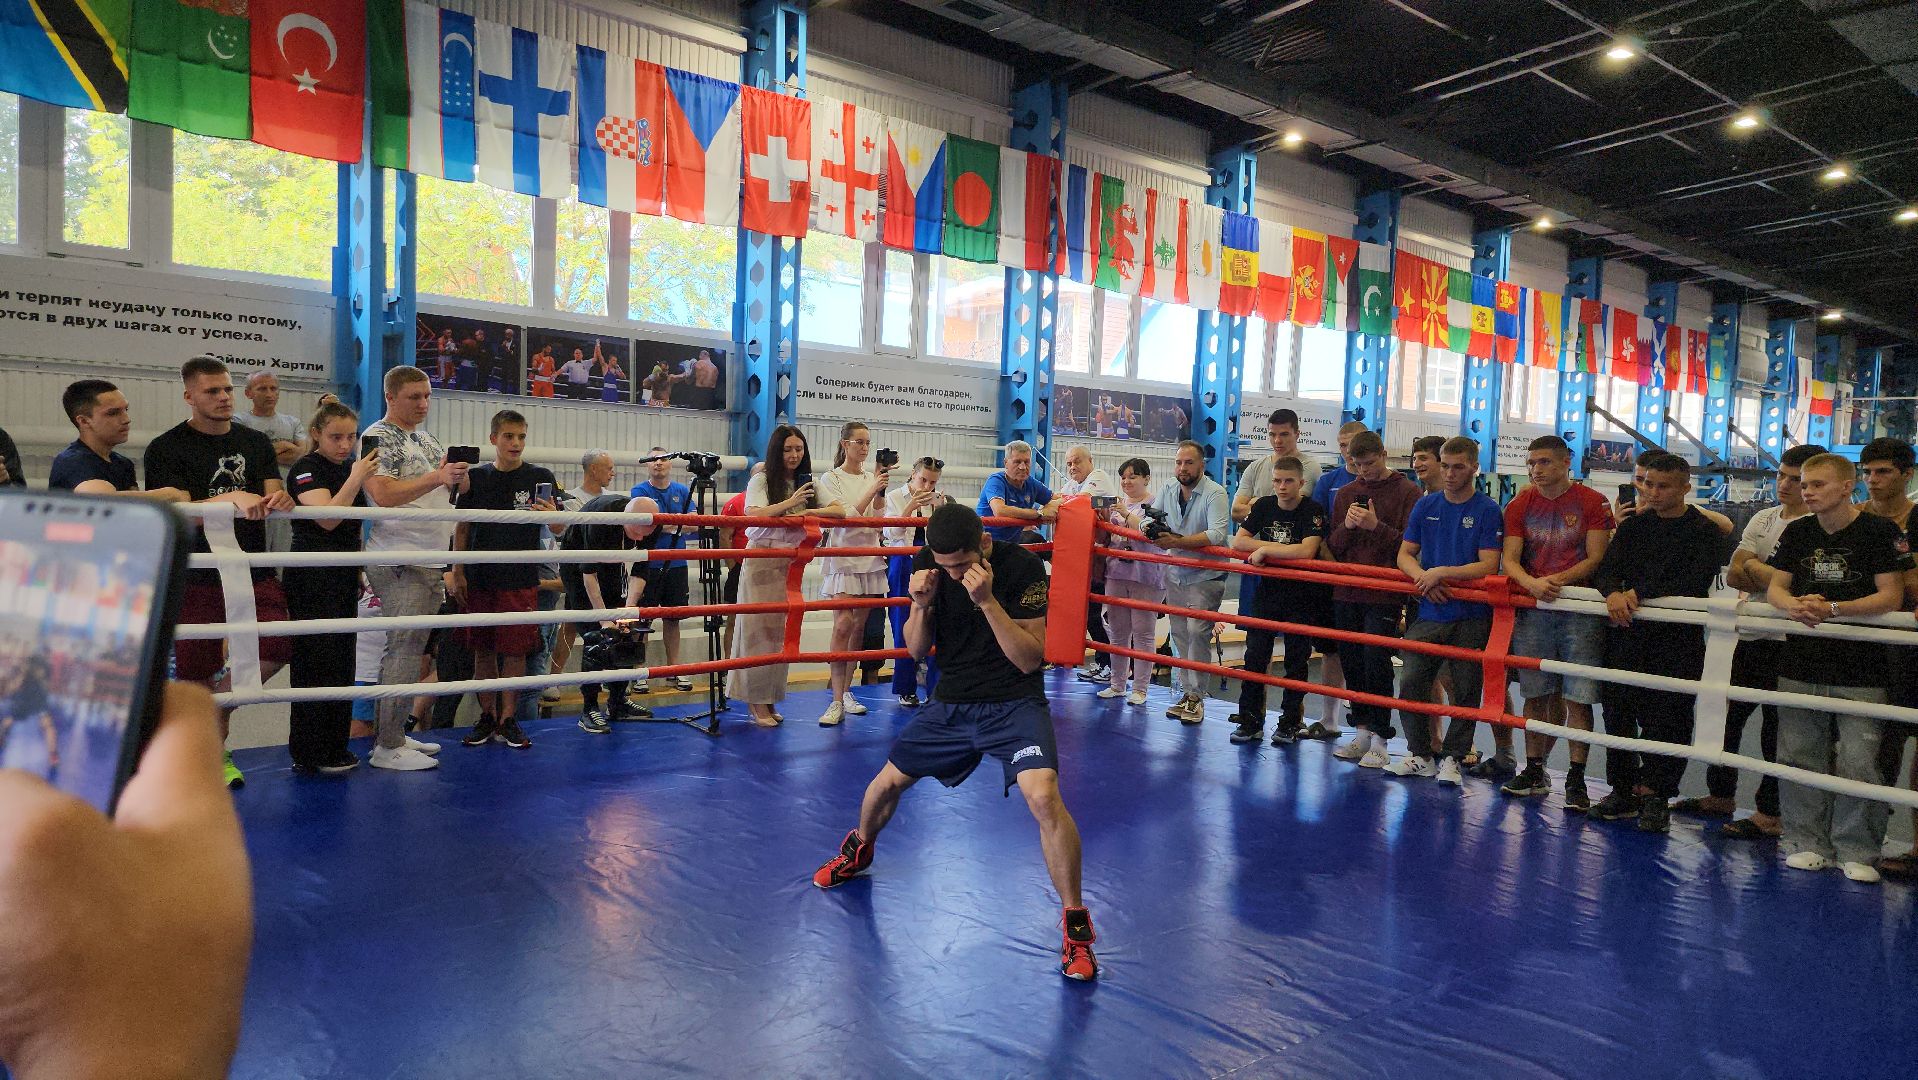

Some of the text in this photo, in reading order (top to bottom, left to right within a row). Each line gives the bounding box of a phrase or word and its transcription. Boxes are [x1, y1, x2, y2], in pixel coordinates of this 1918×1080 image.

[16, 291, 82, 306] терпят
[88, 298, 166, 317] неудачу
[171, 306, 233, 322] только
[238, 314, 302, 331] потому,
[46, 313, 57, 323] в
[62, 315, 108, 329] двух
[114, 319, 172, 334] шагах
[177, 326, 197, 336] от
[201, 327, 268, 343] успеха.
[270, 356, 324, 372] Хартли
[815, 375, 865, 389] Соперник
[868, 380, 895, 393] будет
[897, 385, 915, 394] вам
[796, 389, 816, 399] сли
[818, 392, 832, 400] вы
[835, 393, 848, 401] не
[913, 400, 925, 408] на
[927, 401, 943, 409] сто
